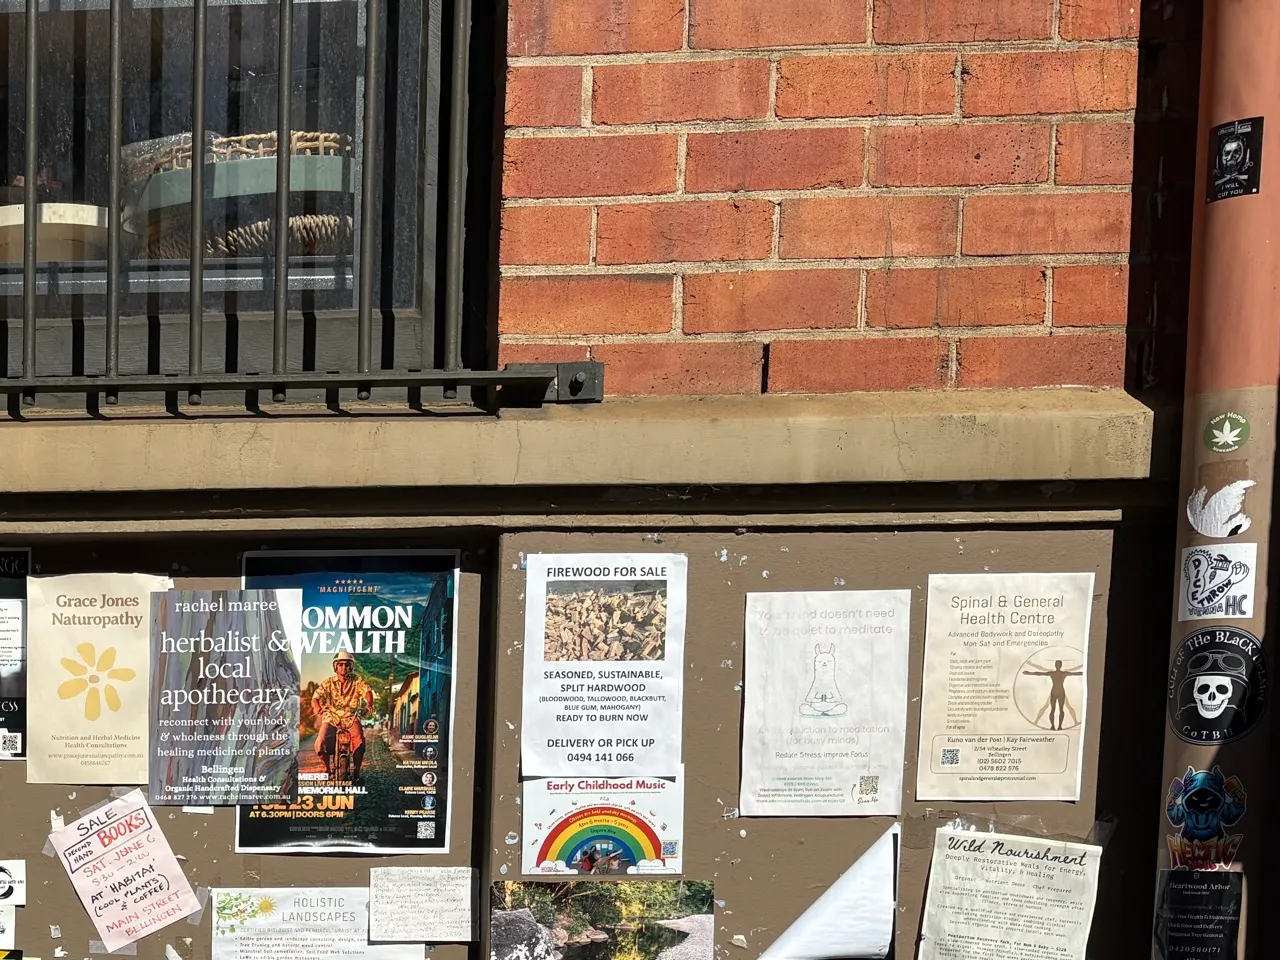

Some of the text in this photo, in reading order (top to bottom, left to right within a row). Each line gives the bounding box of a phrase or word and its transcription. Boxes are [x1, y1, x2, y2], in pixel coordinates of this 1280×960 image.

[1210, 411, 1247, 426] New Hemp
[547, 567, 667, 577] FIREWOOD FOR SALE
[56, 594, 139, 609] Grace Jones
[175, 598, 277, 612] rachel maree
[951, 595, 1064, 611] Spinal & General
[1224, 594, 1247, 616] HC
[52, 612, 143, 628] Naturopathy
[302, 606, 412, 629] OMMON
[960, 612, 1054, 625] Health Centre
[161, 630, 290, 653] herbalist &
[299, 631, 405, 654] WEALTH
[198, 657, 251, 678] local
[161, 683, 289, 712] apothecary
[567, 753, 634, 762] 0494 141 066
[547, 780, 665, 792] Early Childhood Music
[77, 808, 118, 836] SALE
[97, 813, 145, 848] BOOKS
[948, 836, 1088, 867] Wild Nourishment
[293, 898, 345, 907] HOLISTIC
[282, 911, 356, 922] LANDSCAPES
